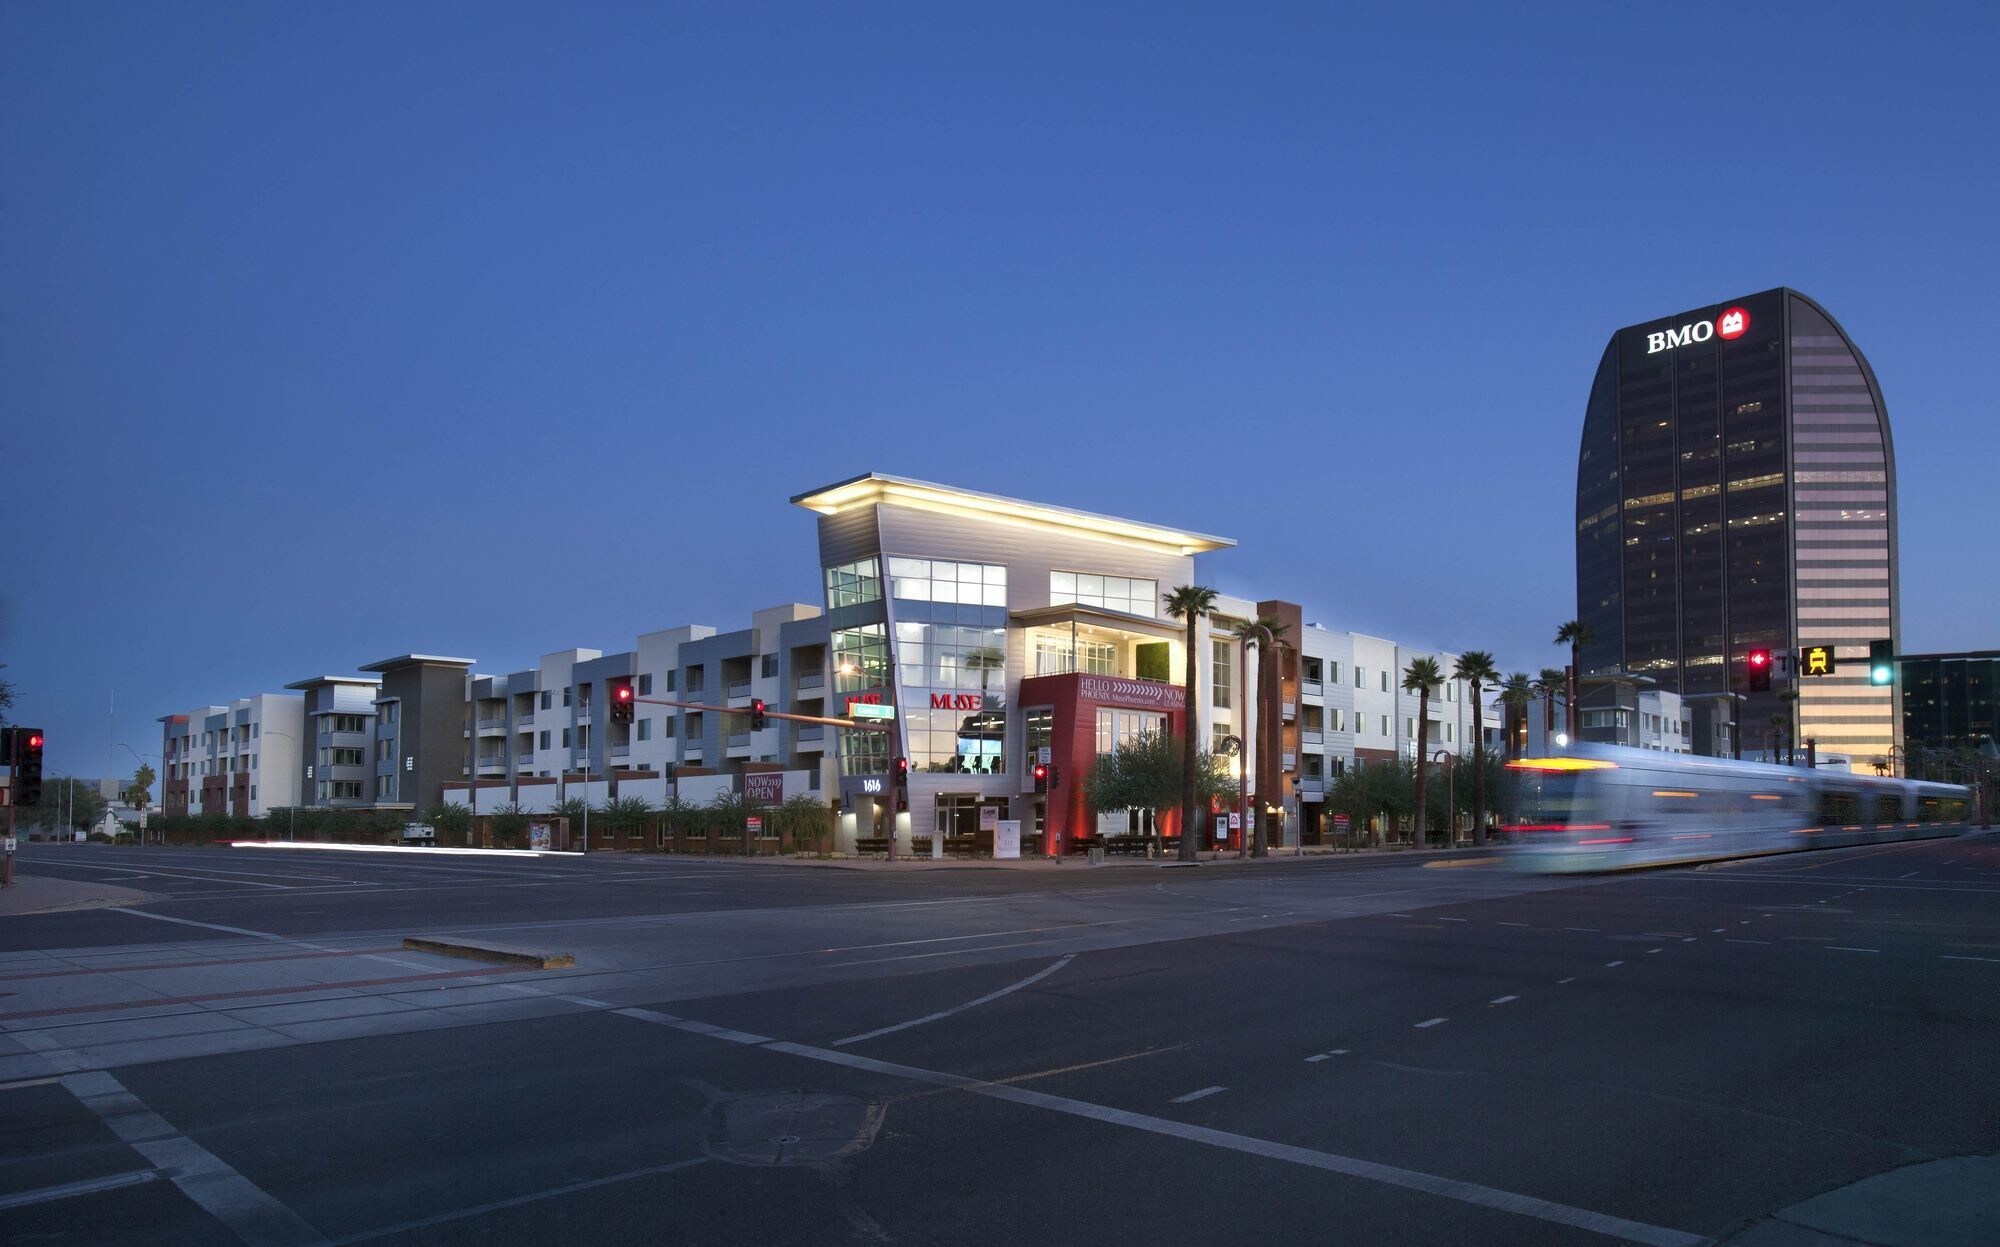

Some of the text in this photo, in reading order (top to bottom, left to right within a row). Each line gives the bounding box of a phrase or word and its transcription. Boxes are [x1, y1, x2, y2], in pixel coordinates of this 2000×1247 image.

[1647, 320, 1714, 354] BMO
[1081, 678, 1110, 692] HELLO
[1081, 689, 1110, 700] PHOENIX
[1165, 688, 1186, 701] NOW
[930, 693, 983, 711] MUSE
[1165, 699, 1186, 709] LEASING
[747, 776, 770, 788] NOW
[863, 779, 881, 792] 1616
[747, 787, 774, 799] OPEN
